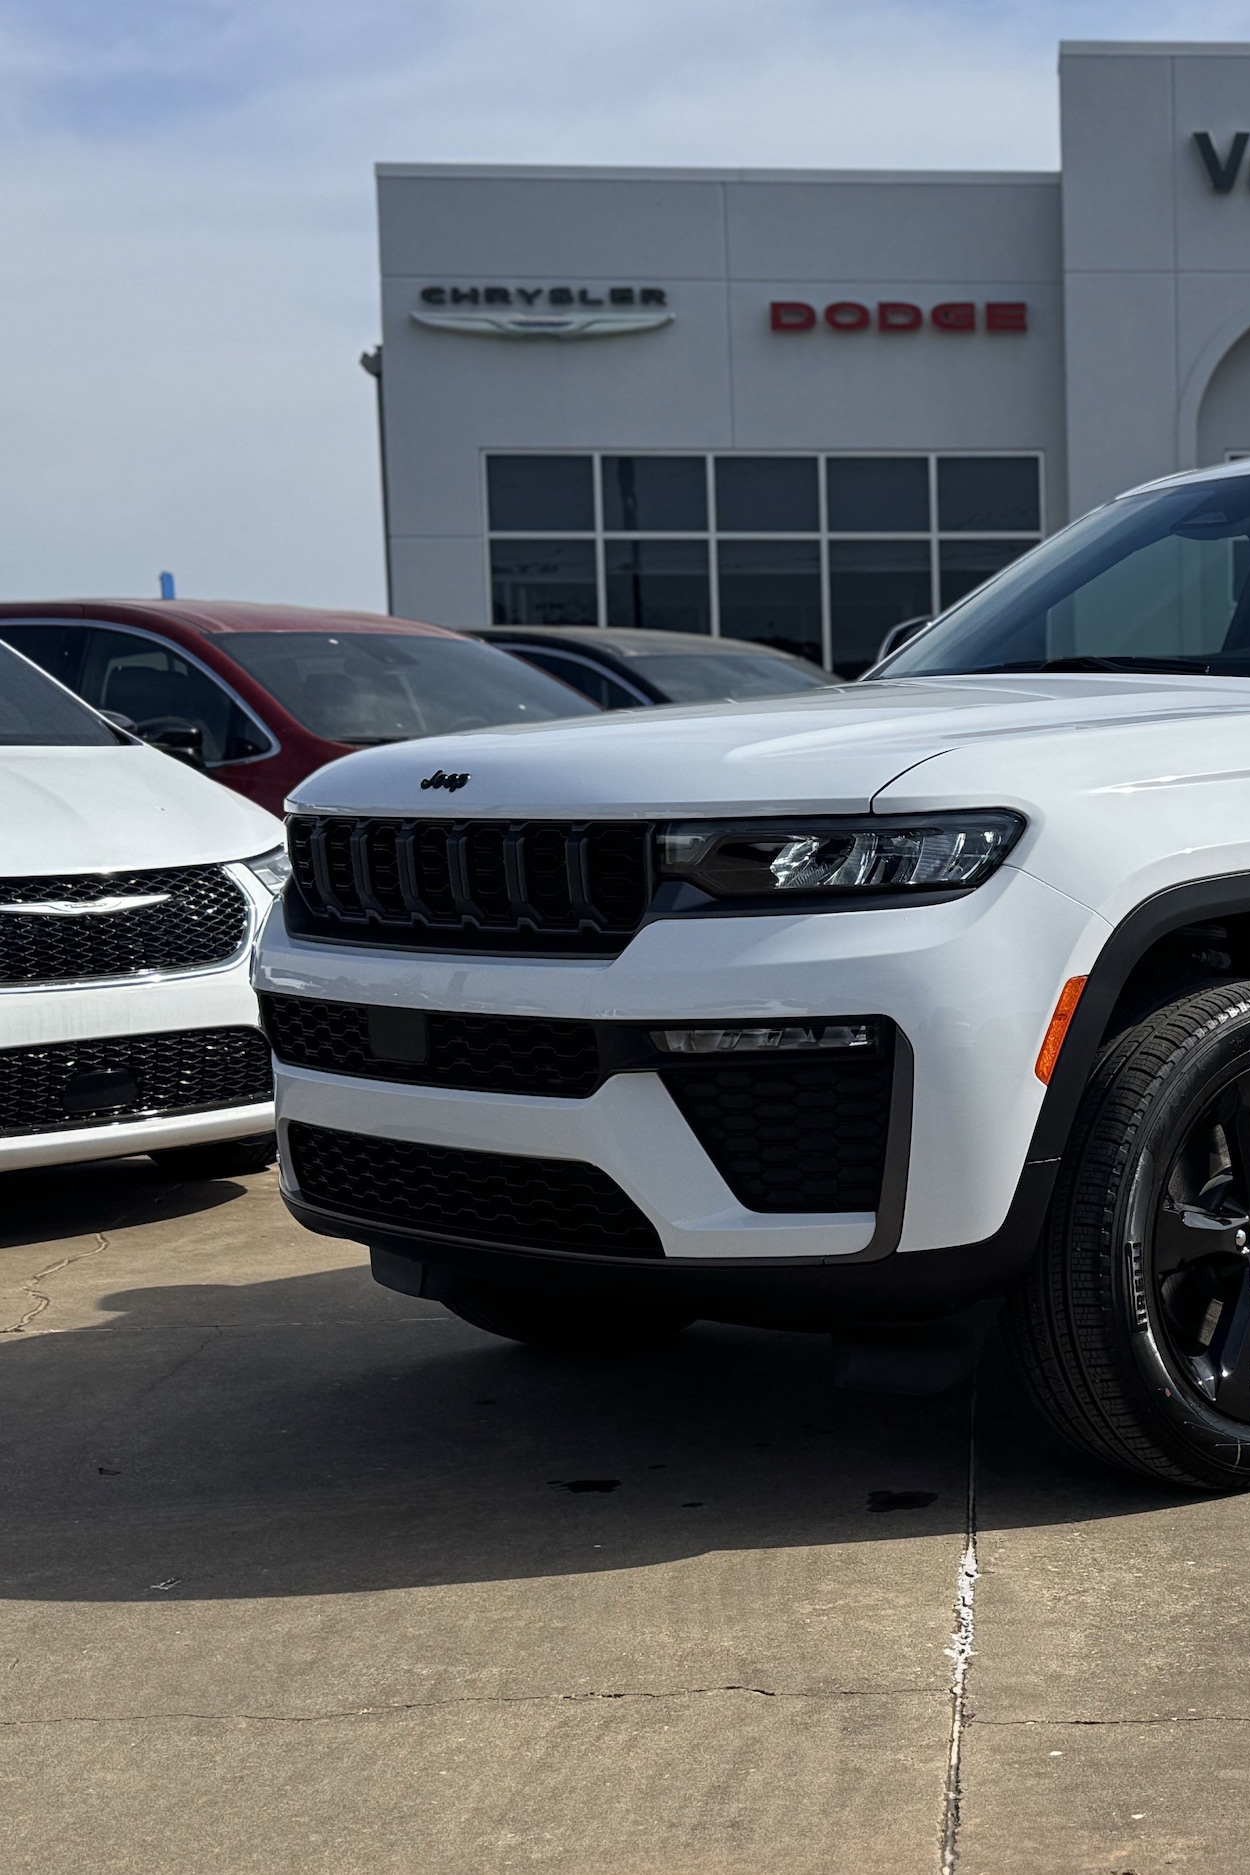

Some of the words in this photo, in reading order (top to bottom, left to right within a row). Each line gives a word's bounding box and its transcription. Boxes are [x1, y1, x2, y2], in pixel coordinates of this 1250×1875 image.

[420, 286, 667, 306] CHRYSLER
[770, 301, 1027, 331] DODGE
[420, 769, 471, 793] Jeep
